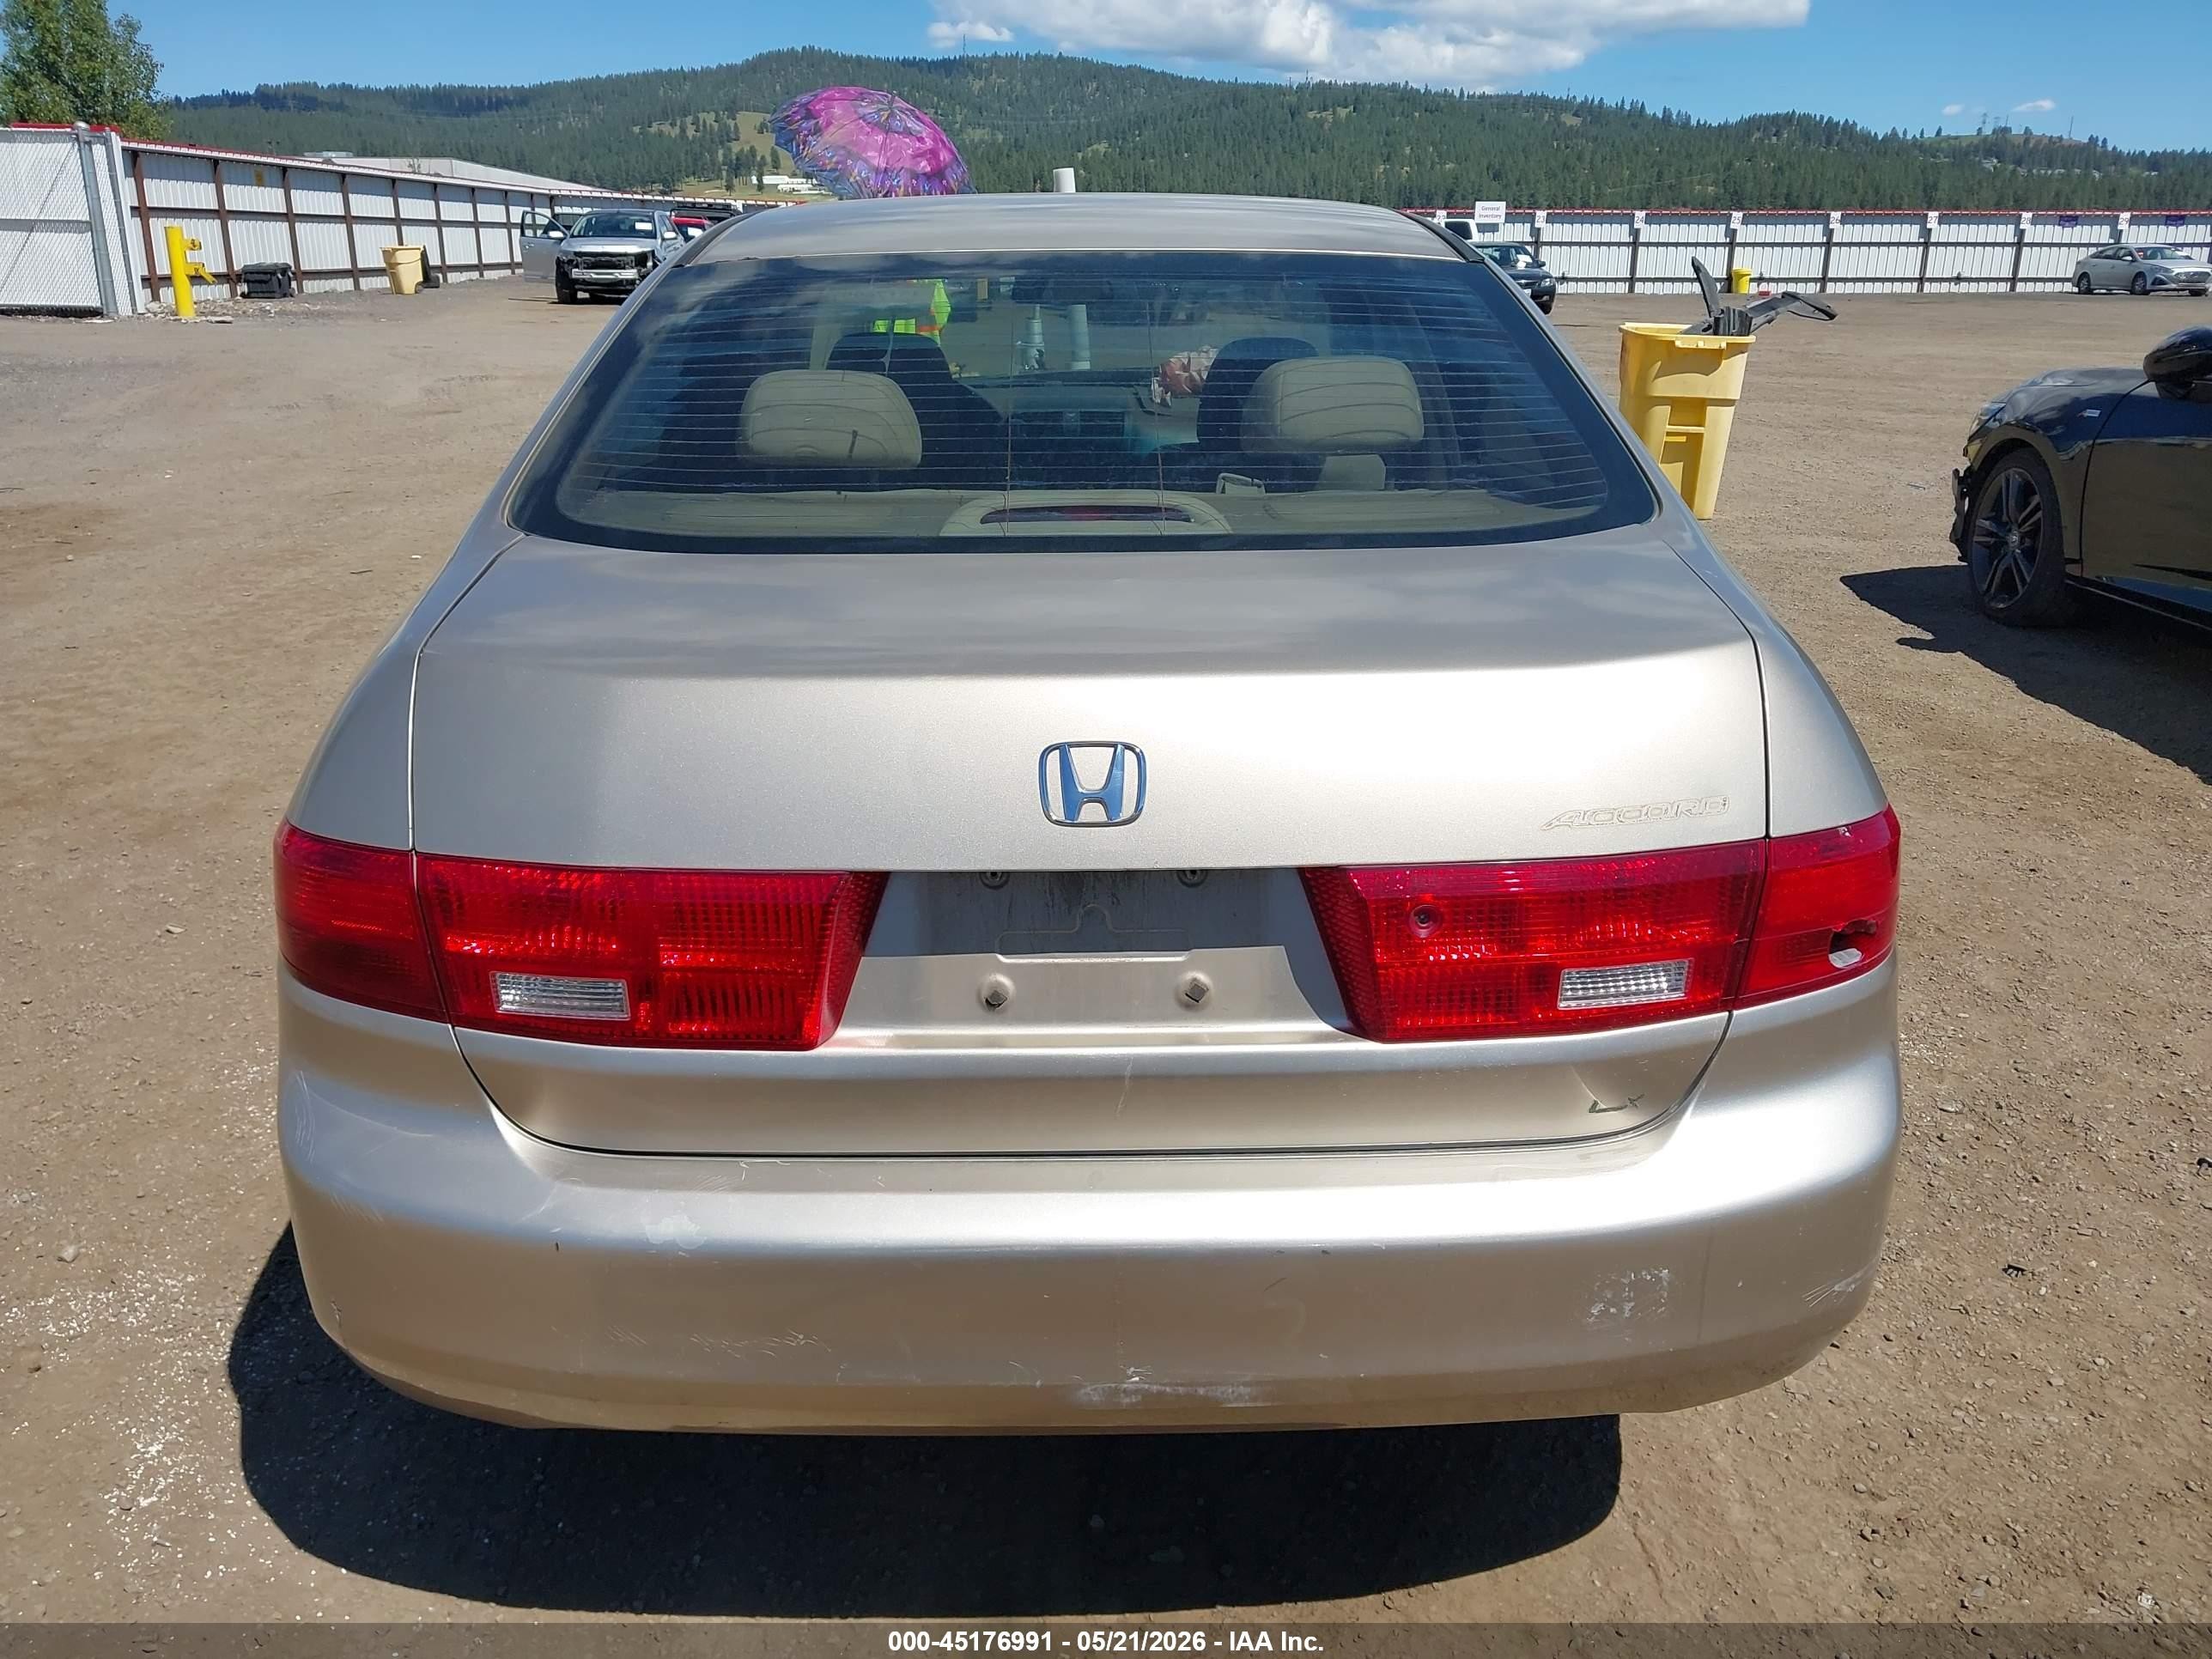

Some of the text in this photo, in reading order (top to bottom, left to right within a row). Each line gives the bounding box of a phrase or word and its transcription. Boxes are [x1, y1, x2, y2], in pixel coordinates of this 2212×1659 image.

[1536, 215, 1546, 223] 23
[1635, 216, 1644, 224] 24
[2021, 216, 2031, 225] 28
[2119, 216, 2130, 225] 29
[1540, 795, 1730, 830] ACCORD
